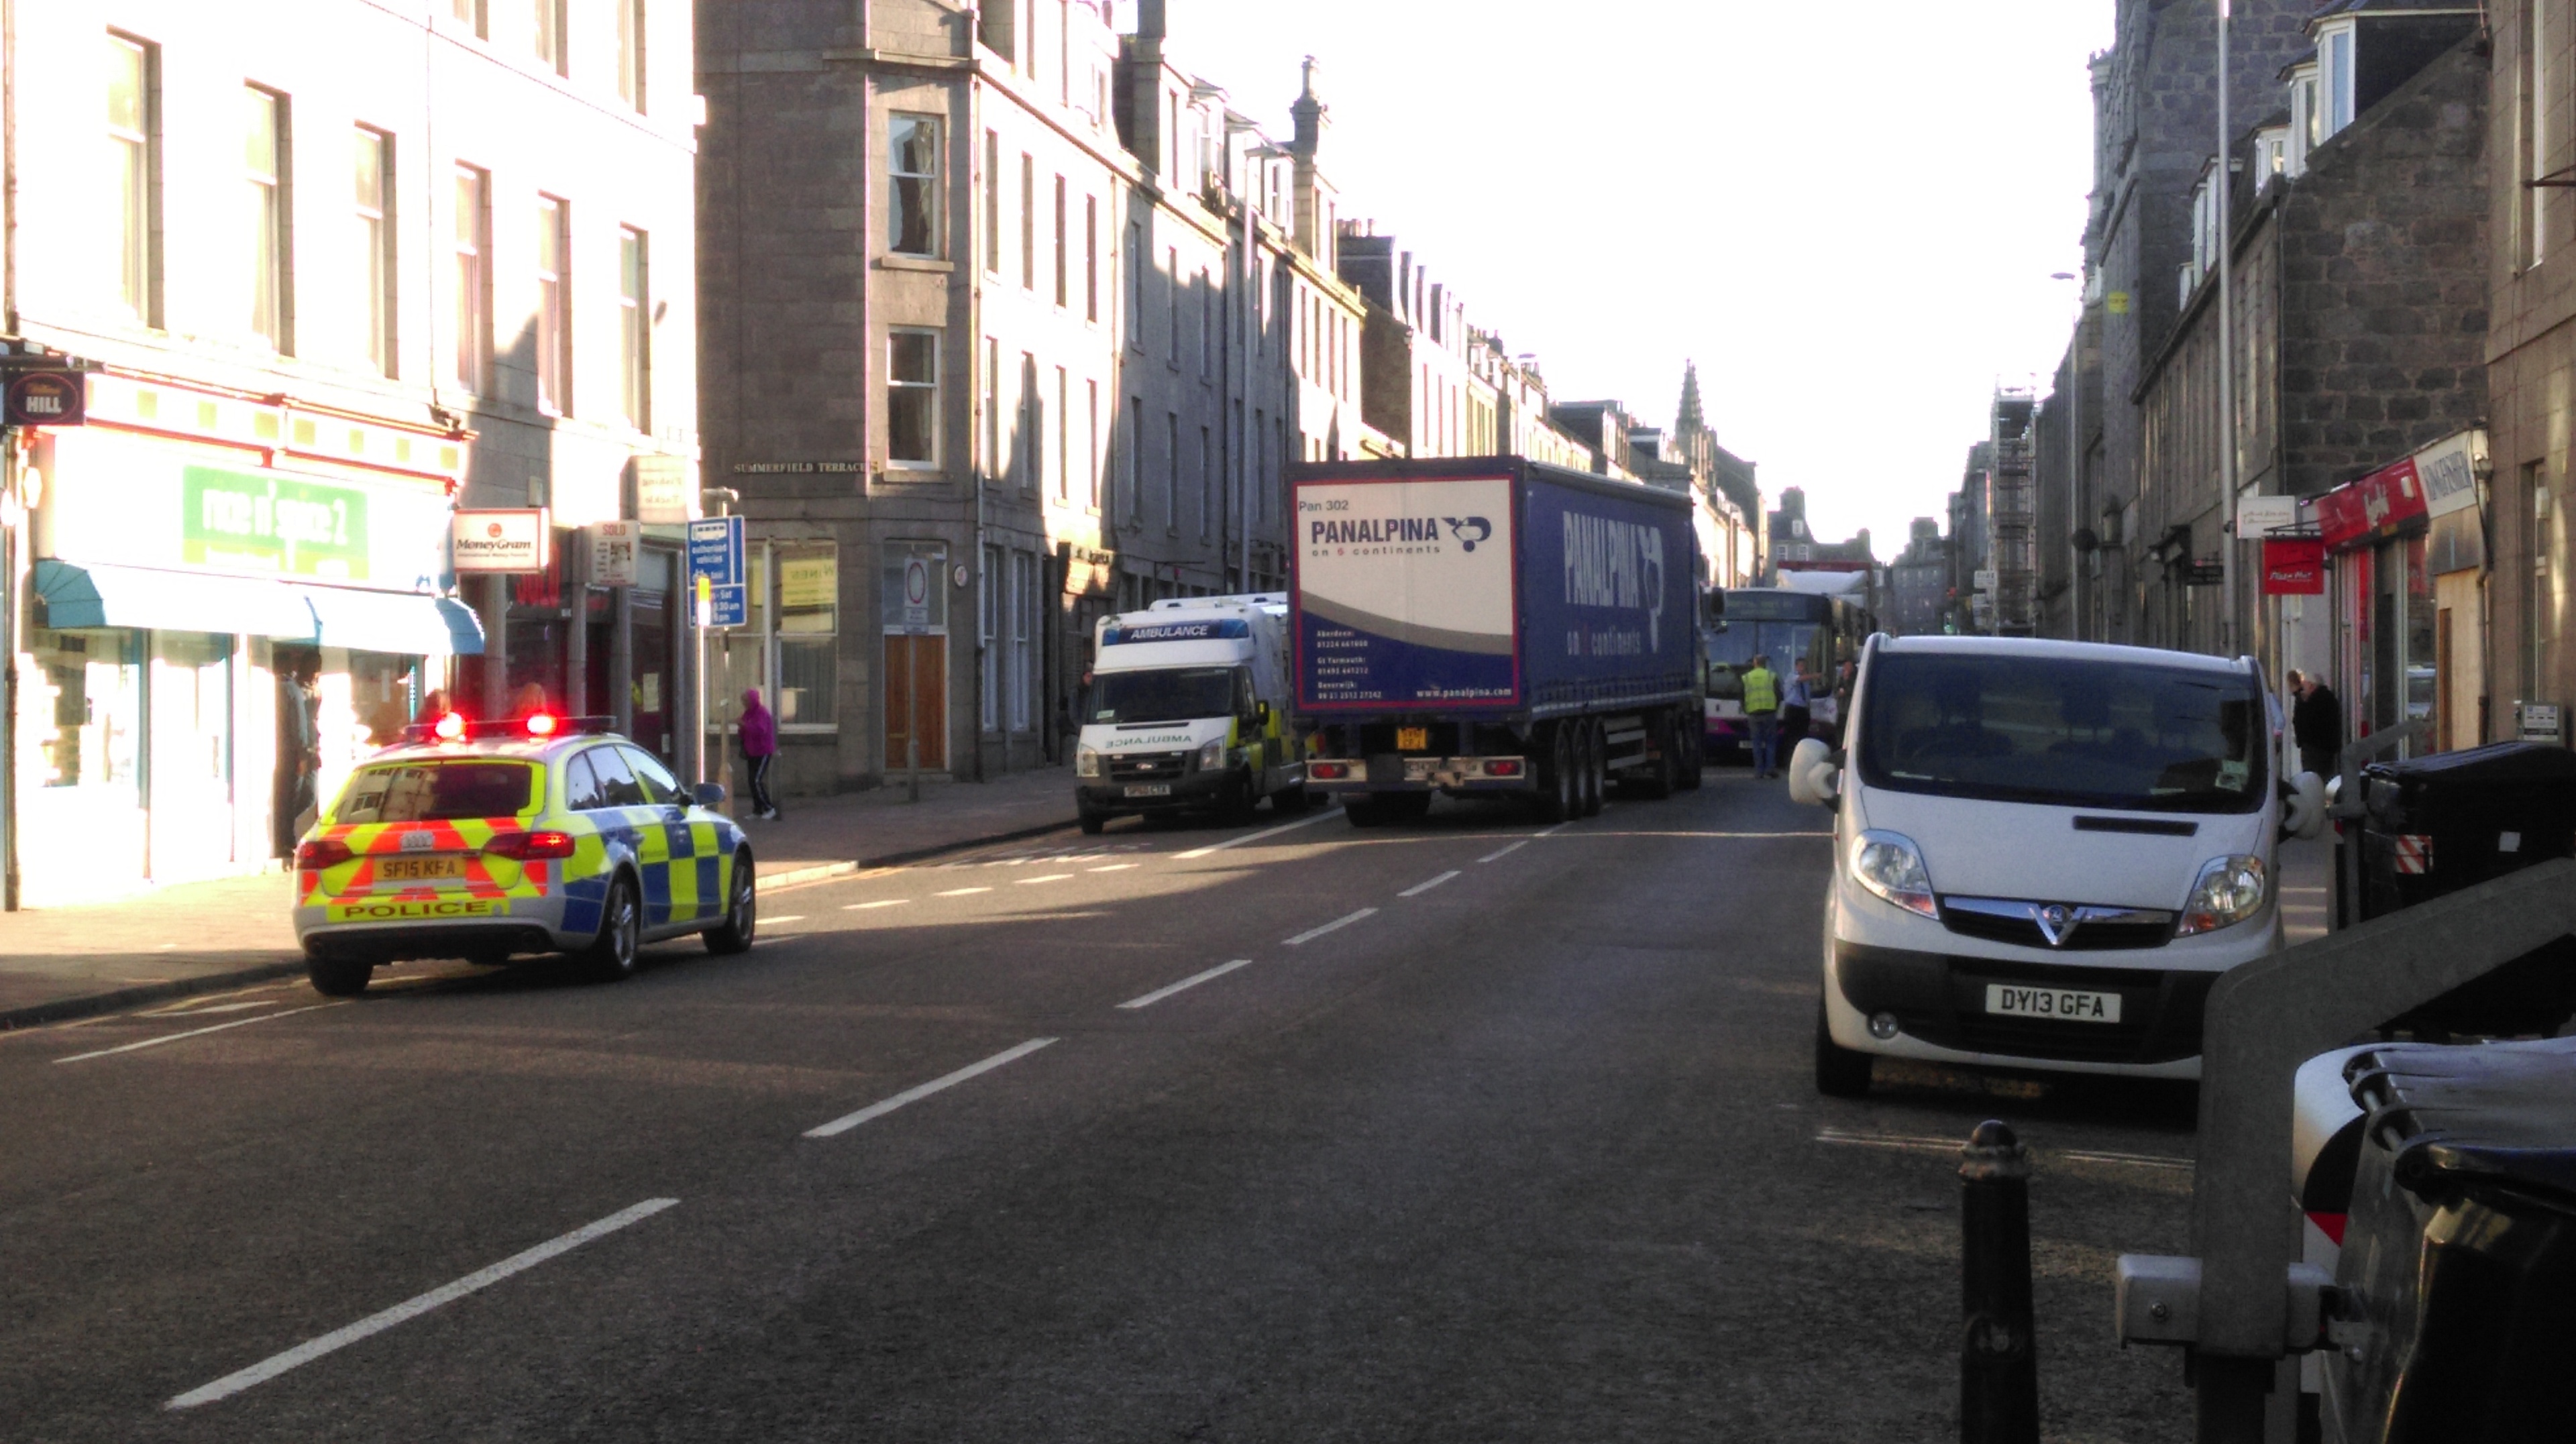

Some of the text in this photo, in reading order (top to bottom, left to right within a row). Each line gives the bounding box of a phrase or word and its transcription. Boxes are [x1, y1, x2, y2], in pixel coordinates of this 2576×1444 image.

[26, 396, 62, 412] HILL
[734, 461, 867, 473] SUMMERFIELD TERRACE
[1299, 500, 1348, 512] Pan 302
[334, 498, 347, 545] 2
[1311, 518, 1438, 544] PANALPINA
[457, 539, 531, 551] MoneyGram
[1313, 545, 1440, 557] on 6 continents
[1563, 510, 1640, 608] PANALPINA
[1130, 624, 1209, 639] AMBULANCE
[1416, 687, 1512, 699] www.panalpina.com
[383, 860, 455, 877] SF15 KFA
[345, 901, 488, 918] POLICE
[2001, 989, 2104, 1017] DY13 GFA
